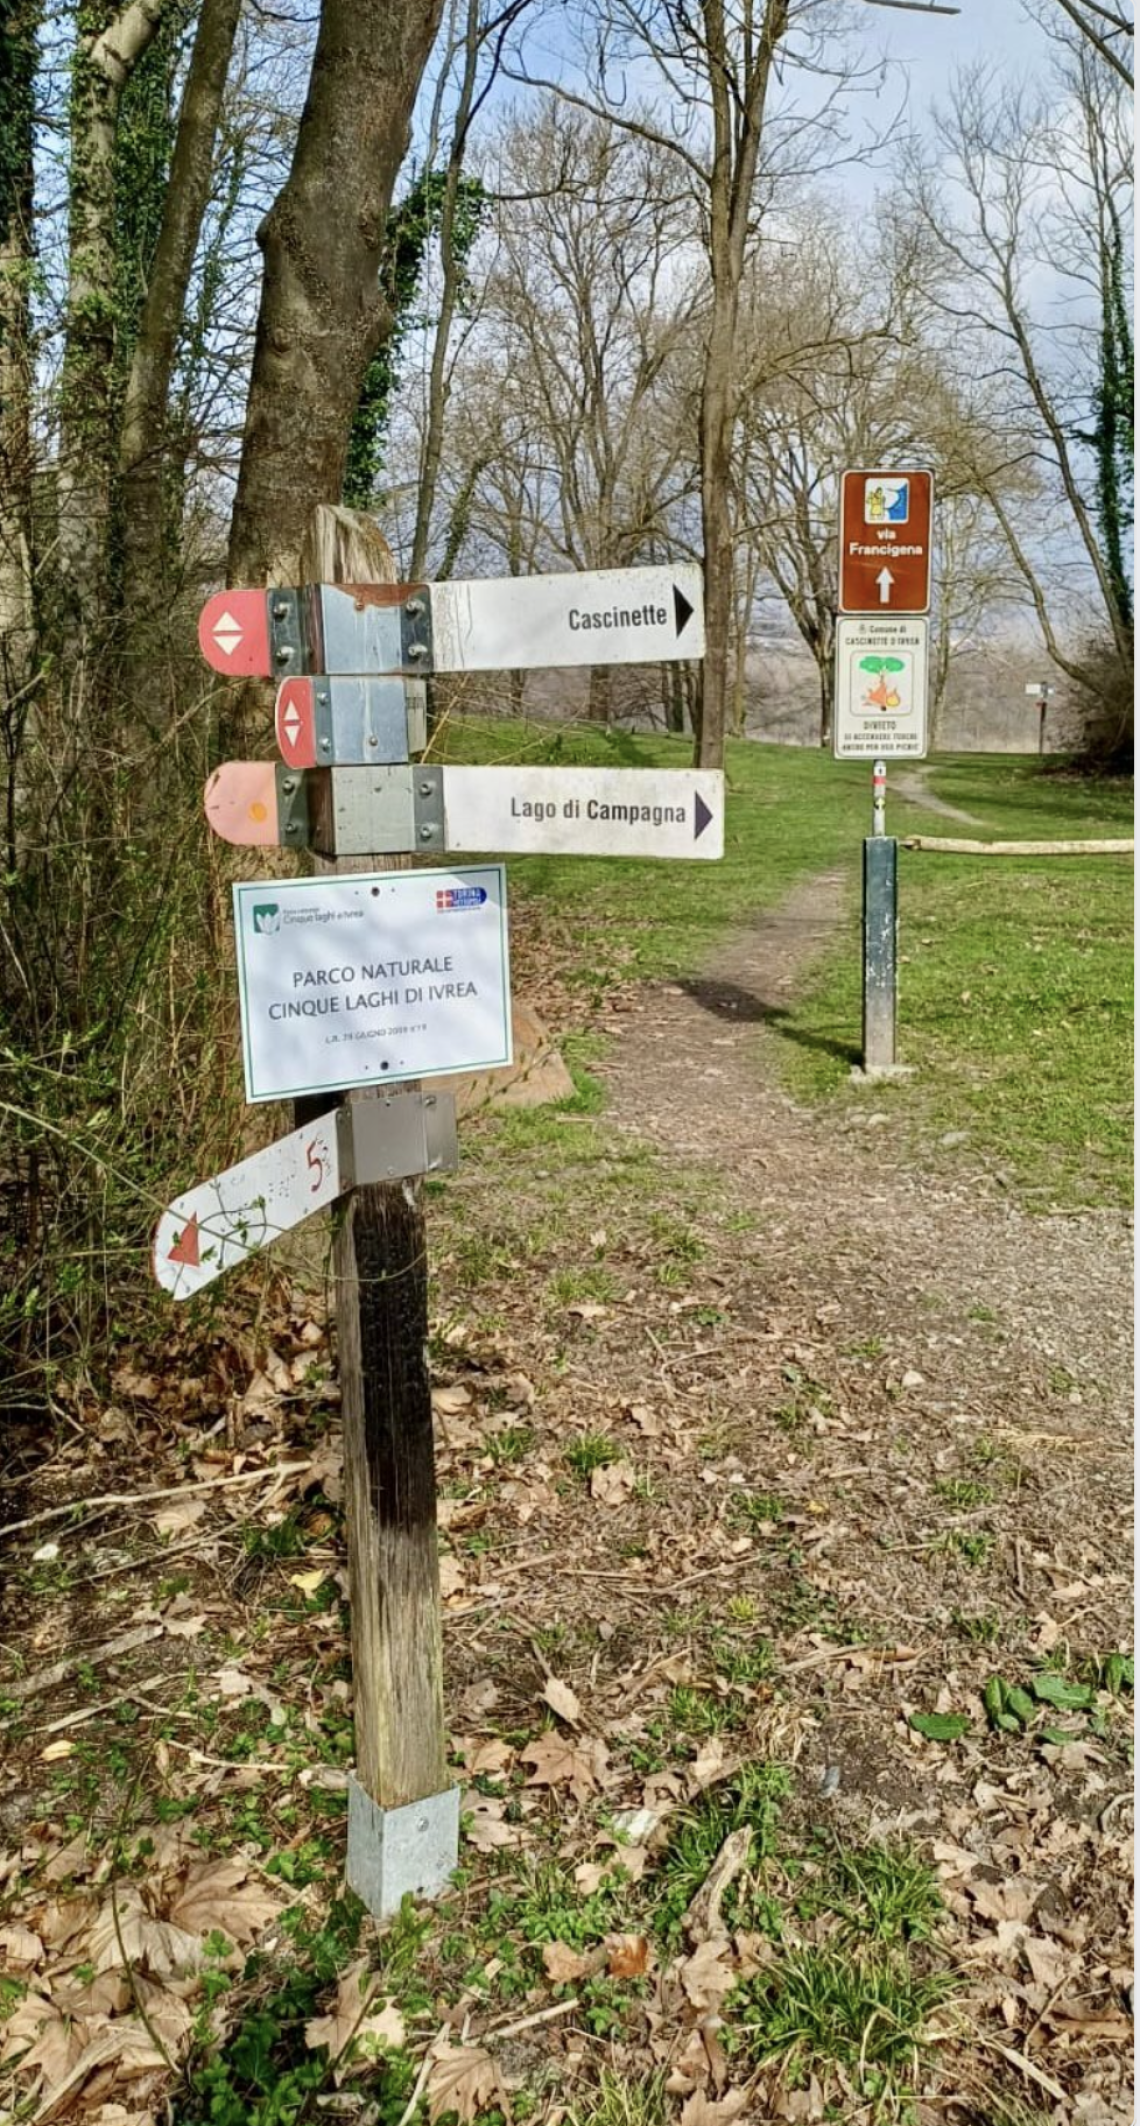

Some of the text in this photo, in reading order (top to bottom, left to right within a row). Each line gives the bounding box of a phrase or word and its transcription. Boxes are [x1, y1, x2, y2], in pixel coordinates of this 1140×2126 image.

[875, 528, 897, 541] via
[848, 541, 924, 558] Francigena
[568, 604, 668, 631] Cascinette
[863, 720, 897, 731] DIVIETO
[510, 796, 687, 827] Lago di Campagna
[282, 913, 314, 927] Cinque
[315, 910, 335, 924] laghi
[292, 956, 454, 988] PARCO NATURALE
[267, 980, 479, 1021] CINQUE LAGHI DI IVREA
